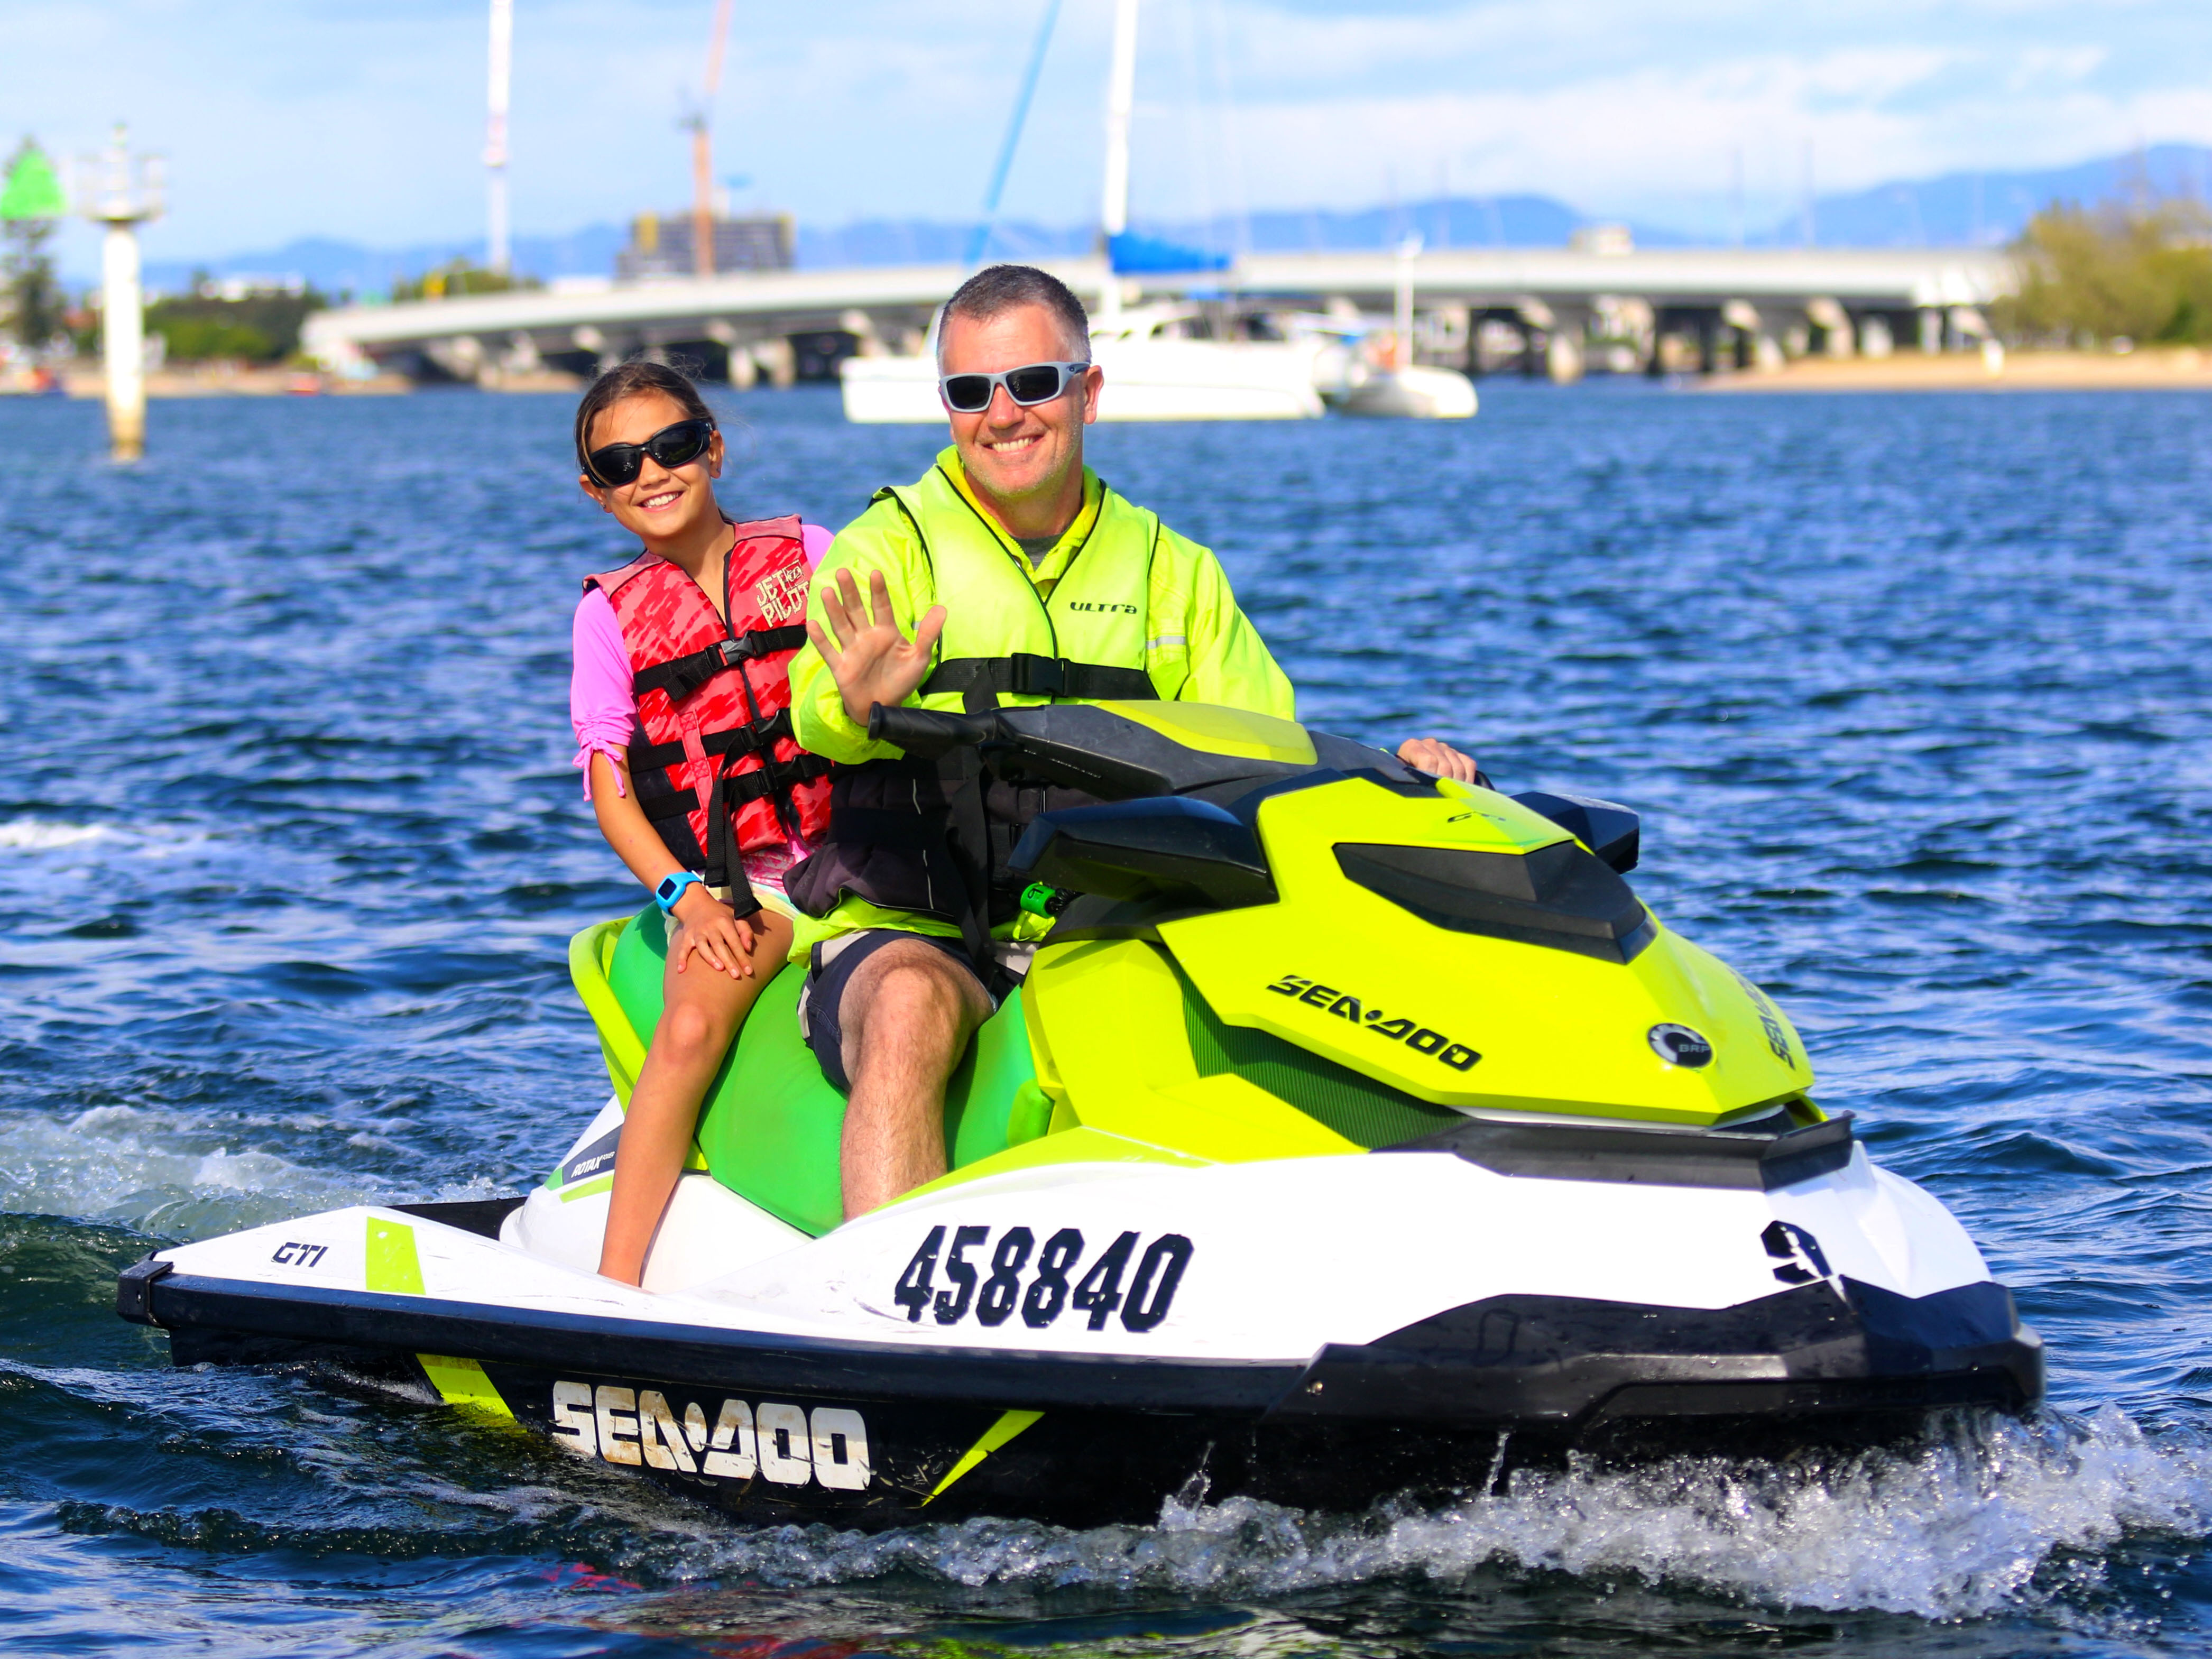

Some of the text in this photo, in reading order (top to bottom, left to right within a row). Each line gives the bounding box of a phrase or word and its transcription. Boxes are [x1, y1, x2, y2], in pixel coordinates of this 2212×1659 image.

[755, 569, 787, 607] JET
[760, 581, 809, 628] PILOT
[1679, 1044, 1710, 1053] BRP
[571, 1155, 603, 1178] ROTAX
[271, 1242, 329, 1268] GTI
[894, 1225, 1194, 1333] 458840
